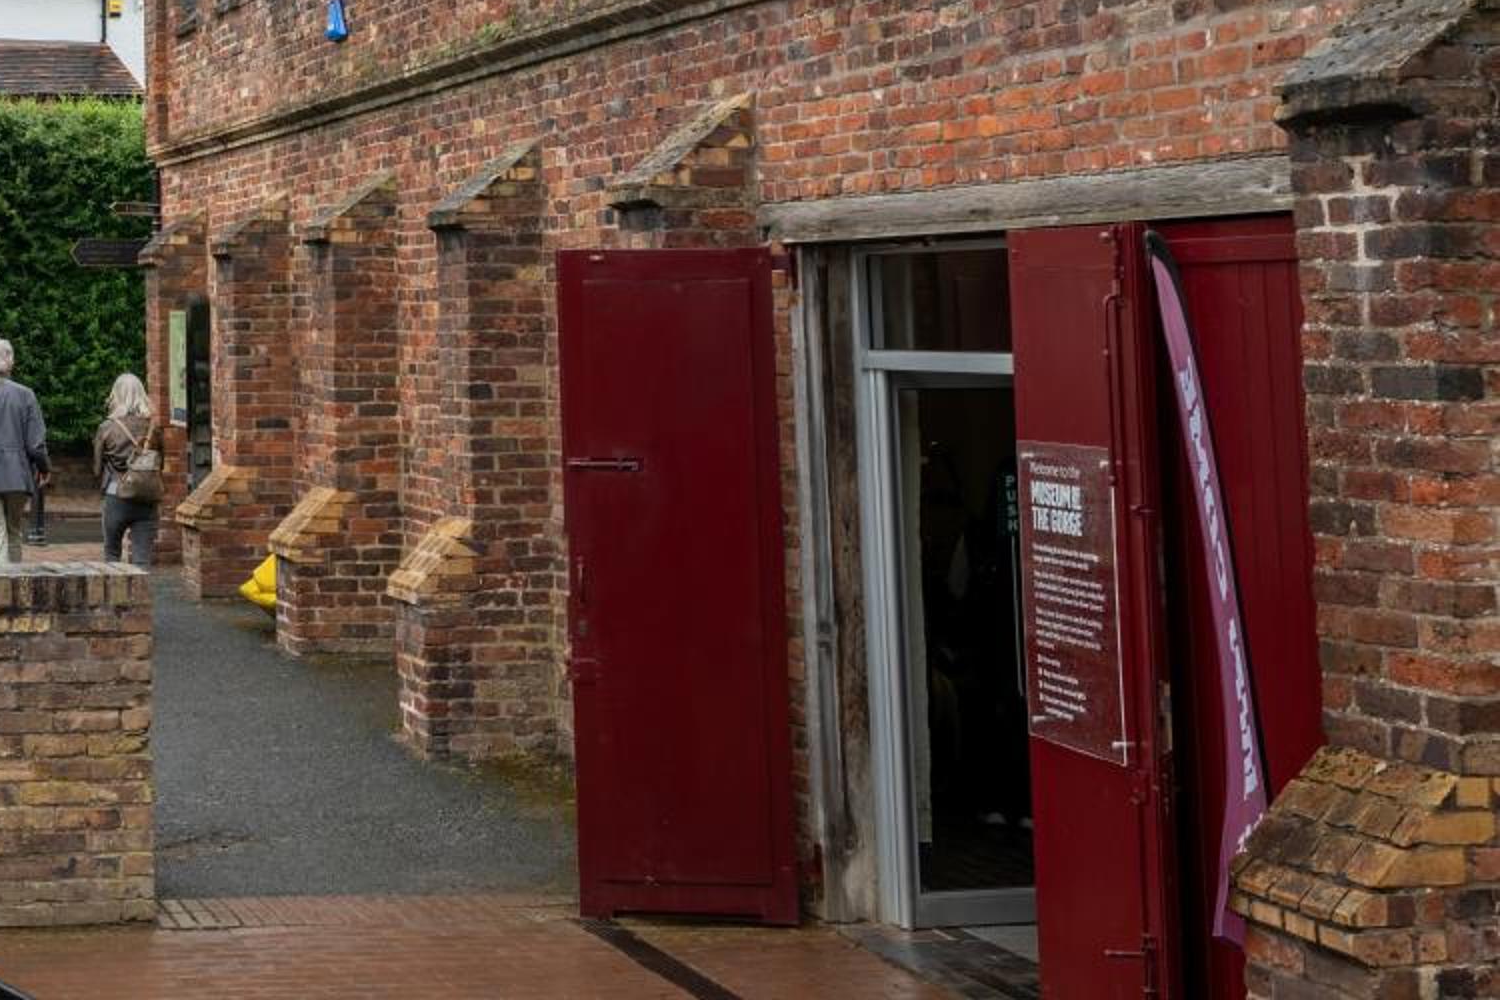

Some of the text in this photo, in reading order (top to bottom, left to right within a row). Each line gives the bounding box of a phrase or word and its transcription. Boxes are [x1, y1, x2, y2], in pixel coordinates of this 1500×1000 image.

[1030, 480, 1071, 509] MUSEUM
[1031, 505, 1083, 536] THE GORGE
